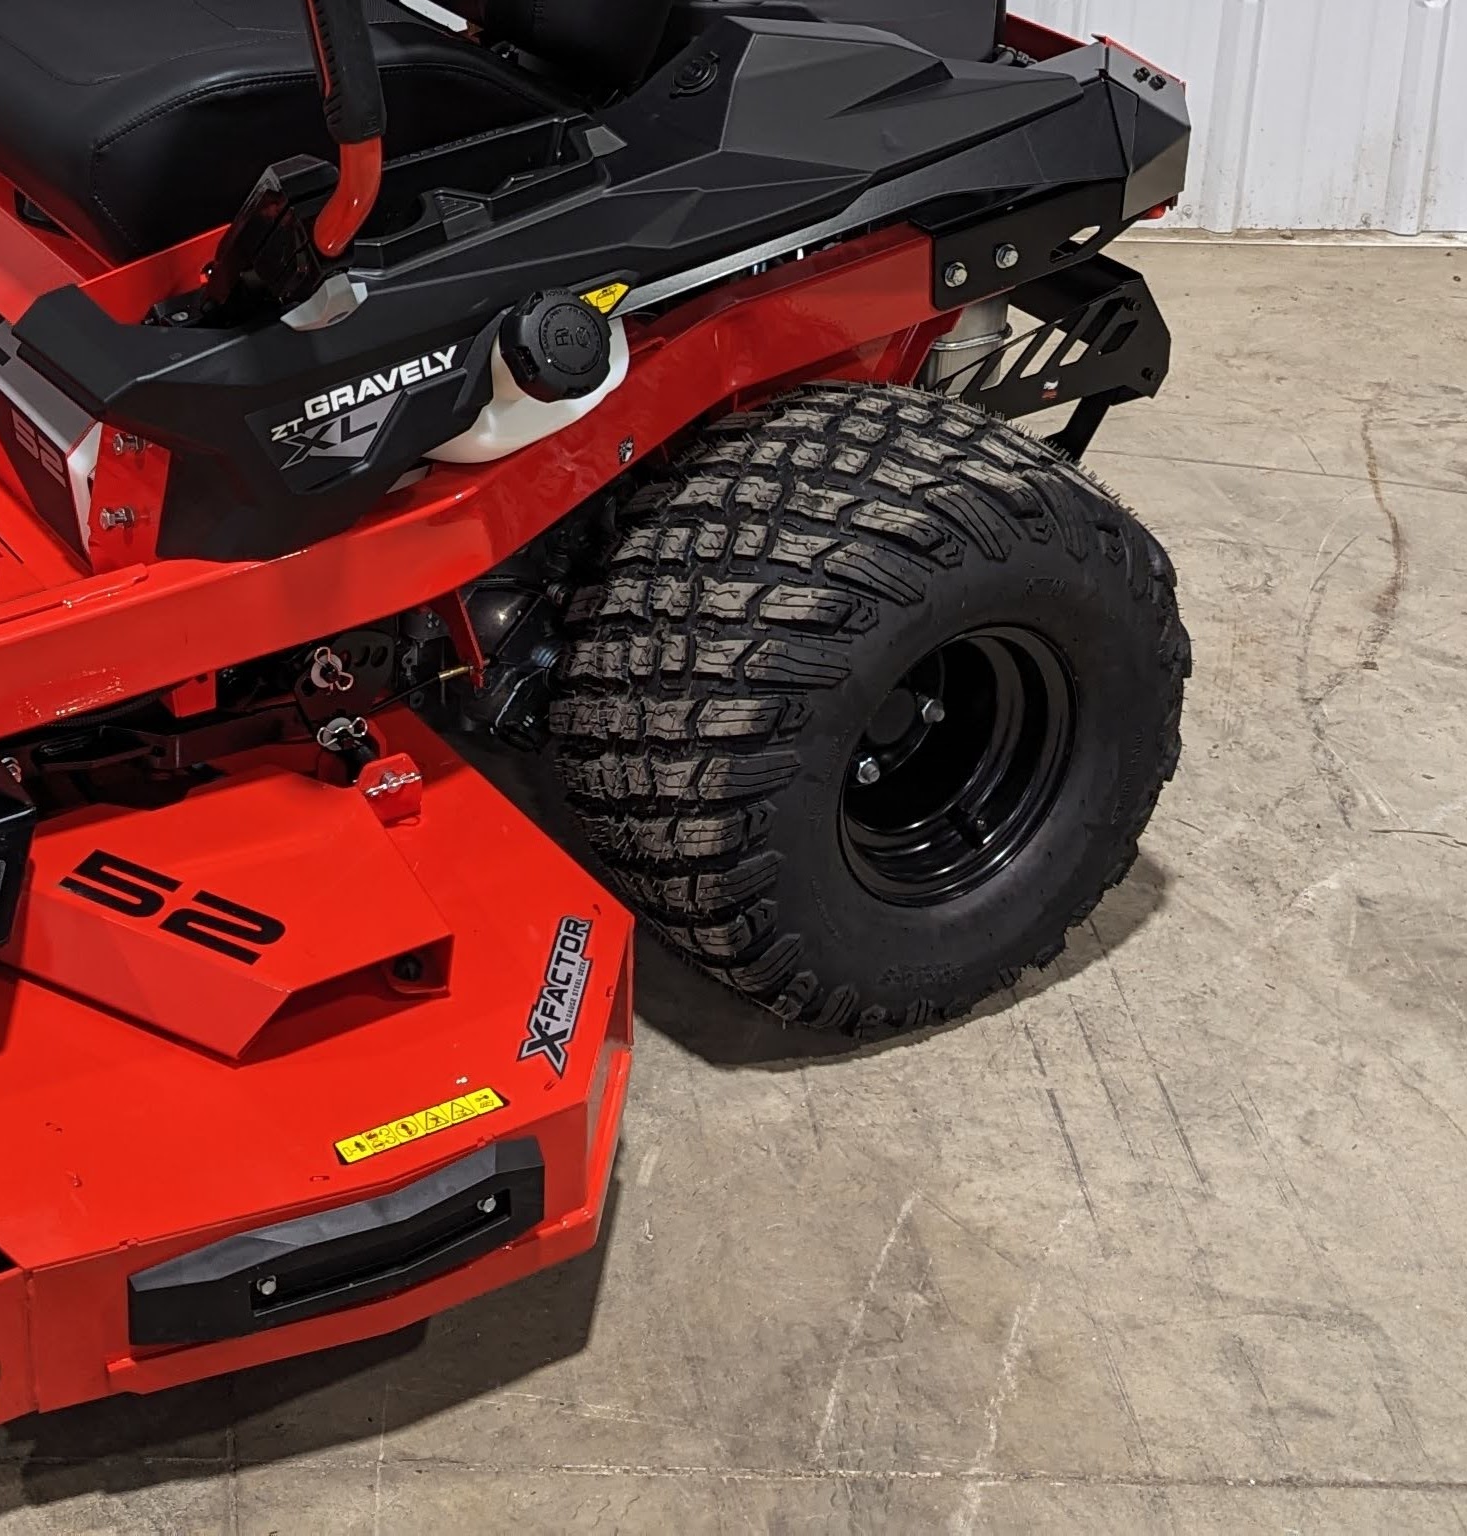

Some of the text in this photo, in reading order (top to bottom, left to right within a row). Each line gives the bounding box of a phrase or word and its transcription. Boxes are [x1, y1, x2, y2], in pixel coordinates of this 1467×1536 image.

[304, 345, 458, 421] GRAVELY
[10, 408, 67, 488] 52
[270, 415, 378, 469] ZT XL
[58, 849, 286, 965] 52
[525, 918, 589, 1065] X-FACTOR
[572, 978, 583, 997] STEEL
